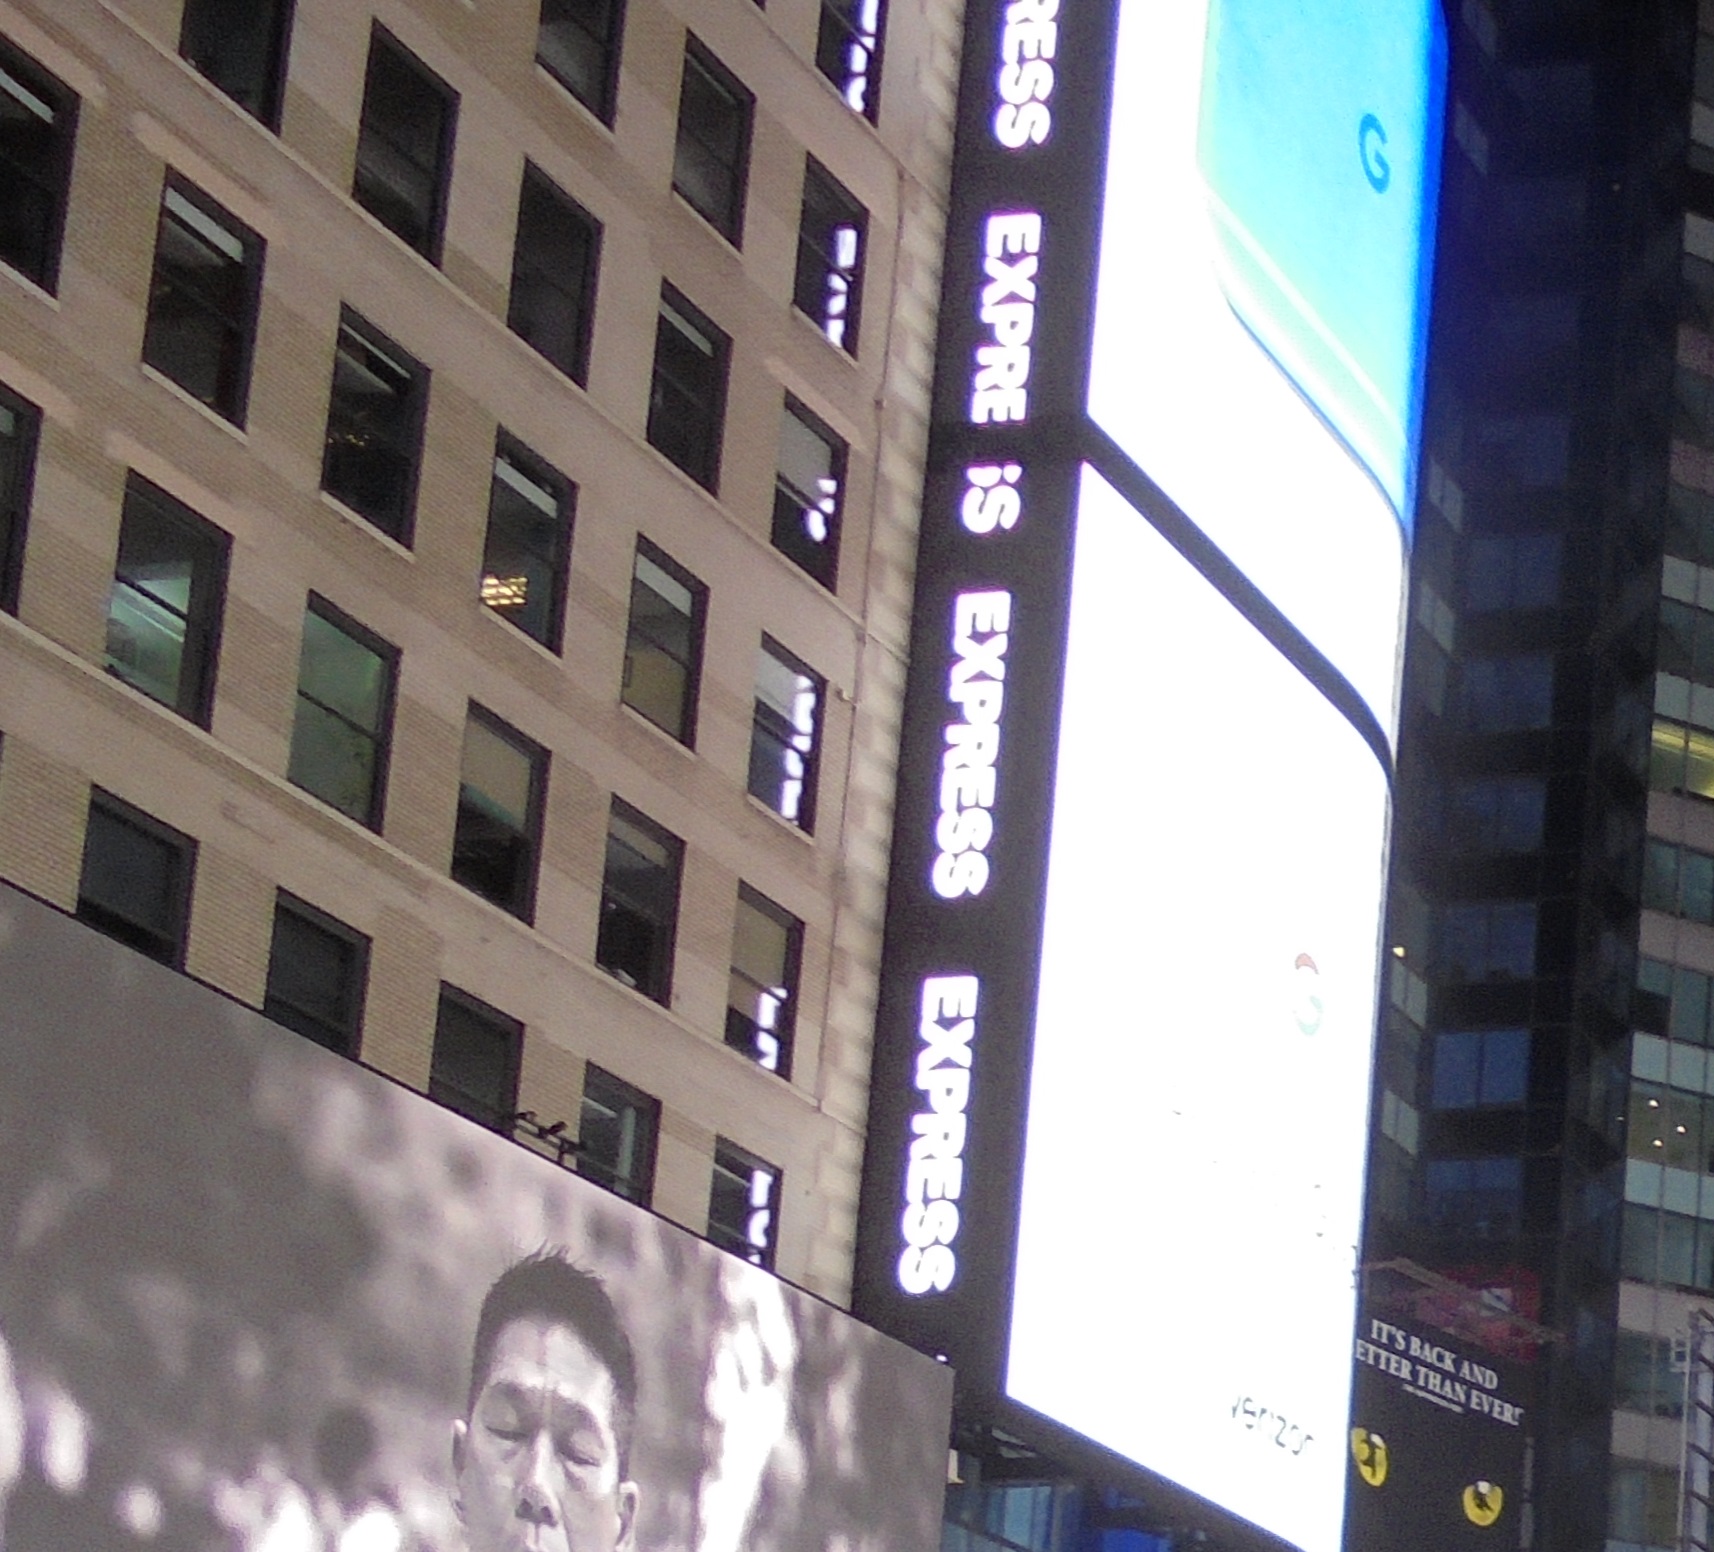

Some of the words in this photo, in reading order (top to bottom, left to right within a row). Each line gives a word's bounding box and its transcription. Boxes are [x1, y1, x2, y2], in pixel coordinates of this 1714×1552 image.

[1358, 112, 1390, 193] G
[932, 590, 1012, 899] EXPRESS
[900, 975, 979, 1294] EXPRESS
[1356, 1338, 1413, 1381] ETTER
[1416, 1365, 1467, 1404] THAN
[1371, 1318, 1407, 1351] IT'S
[1409, 1335, 1457, 1374] BACK
[1459, 1359, 1498, 1390] AND
